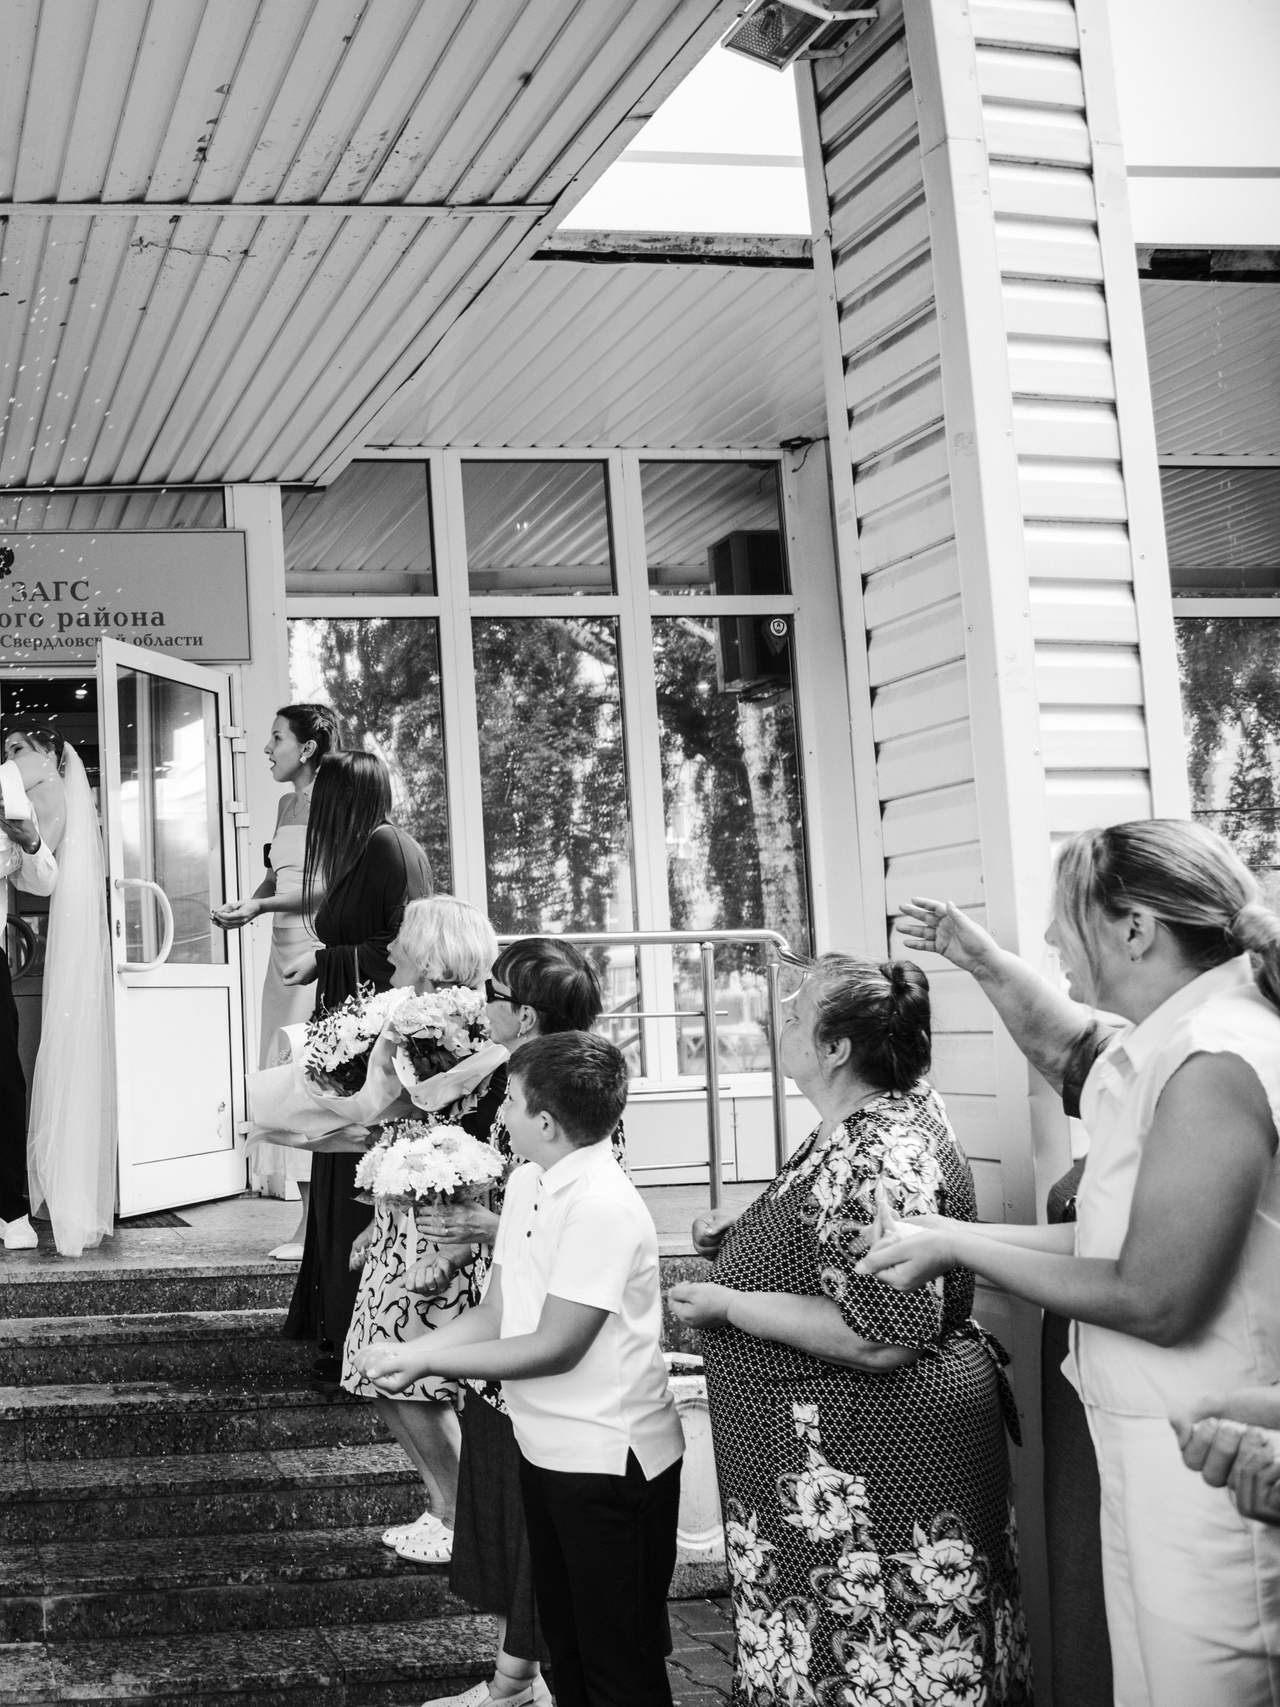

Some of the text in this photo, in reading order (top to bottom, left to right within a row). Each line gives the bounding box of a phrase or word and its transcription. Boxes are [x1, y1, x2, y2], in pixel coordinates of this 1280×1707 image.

[11, 580, 90, 602] ЗАГС
[57, 607, 165, 633] района
[0, 634, 126, 650] Свердловскй
[133, 633, 204, 647] области
